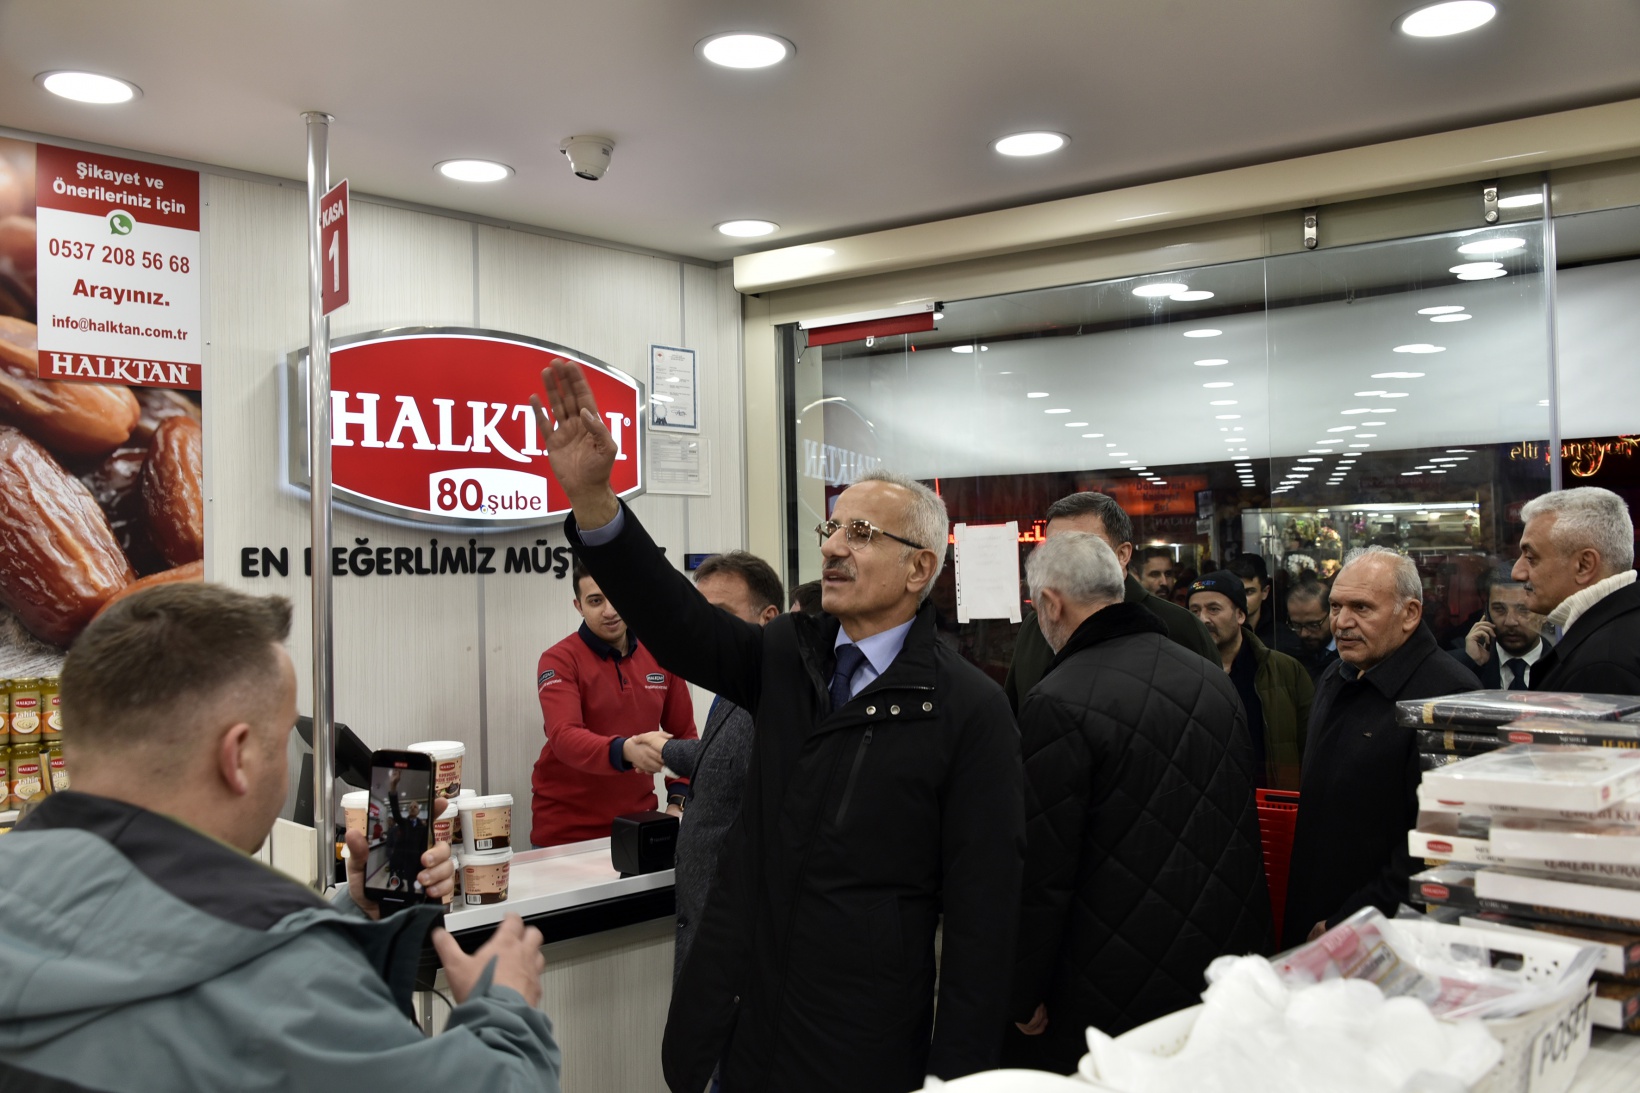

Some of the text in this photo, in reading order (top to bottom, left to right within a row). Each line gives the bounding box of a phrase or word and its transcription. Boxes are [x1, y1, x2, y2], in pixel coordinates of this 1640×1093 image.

[76, 161, 164, 190] Şikayet ve
[52, 176, 186, 215] Önerileriniz için
[322, 199, 344, 229] KASA
[48, 238, 190, 274] 0537 208 56 68
[328, 229, 340, 293] 1
[72, 278, 170, 307] Arayınız.
[52, 315, 188, 341] info@halktan.com.tr
[50, 352, 190, 385] HALKTAN
[436, 477, 542, 516] 80 şube
[241, 547, 289, 578] EN
